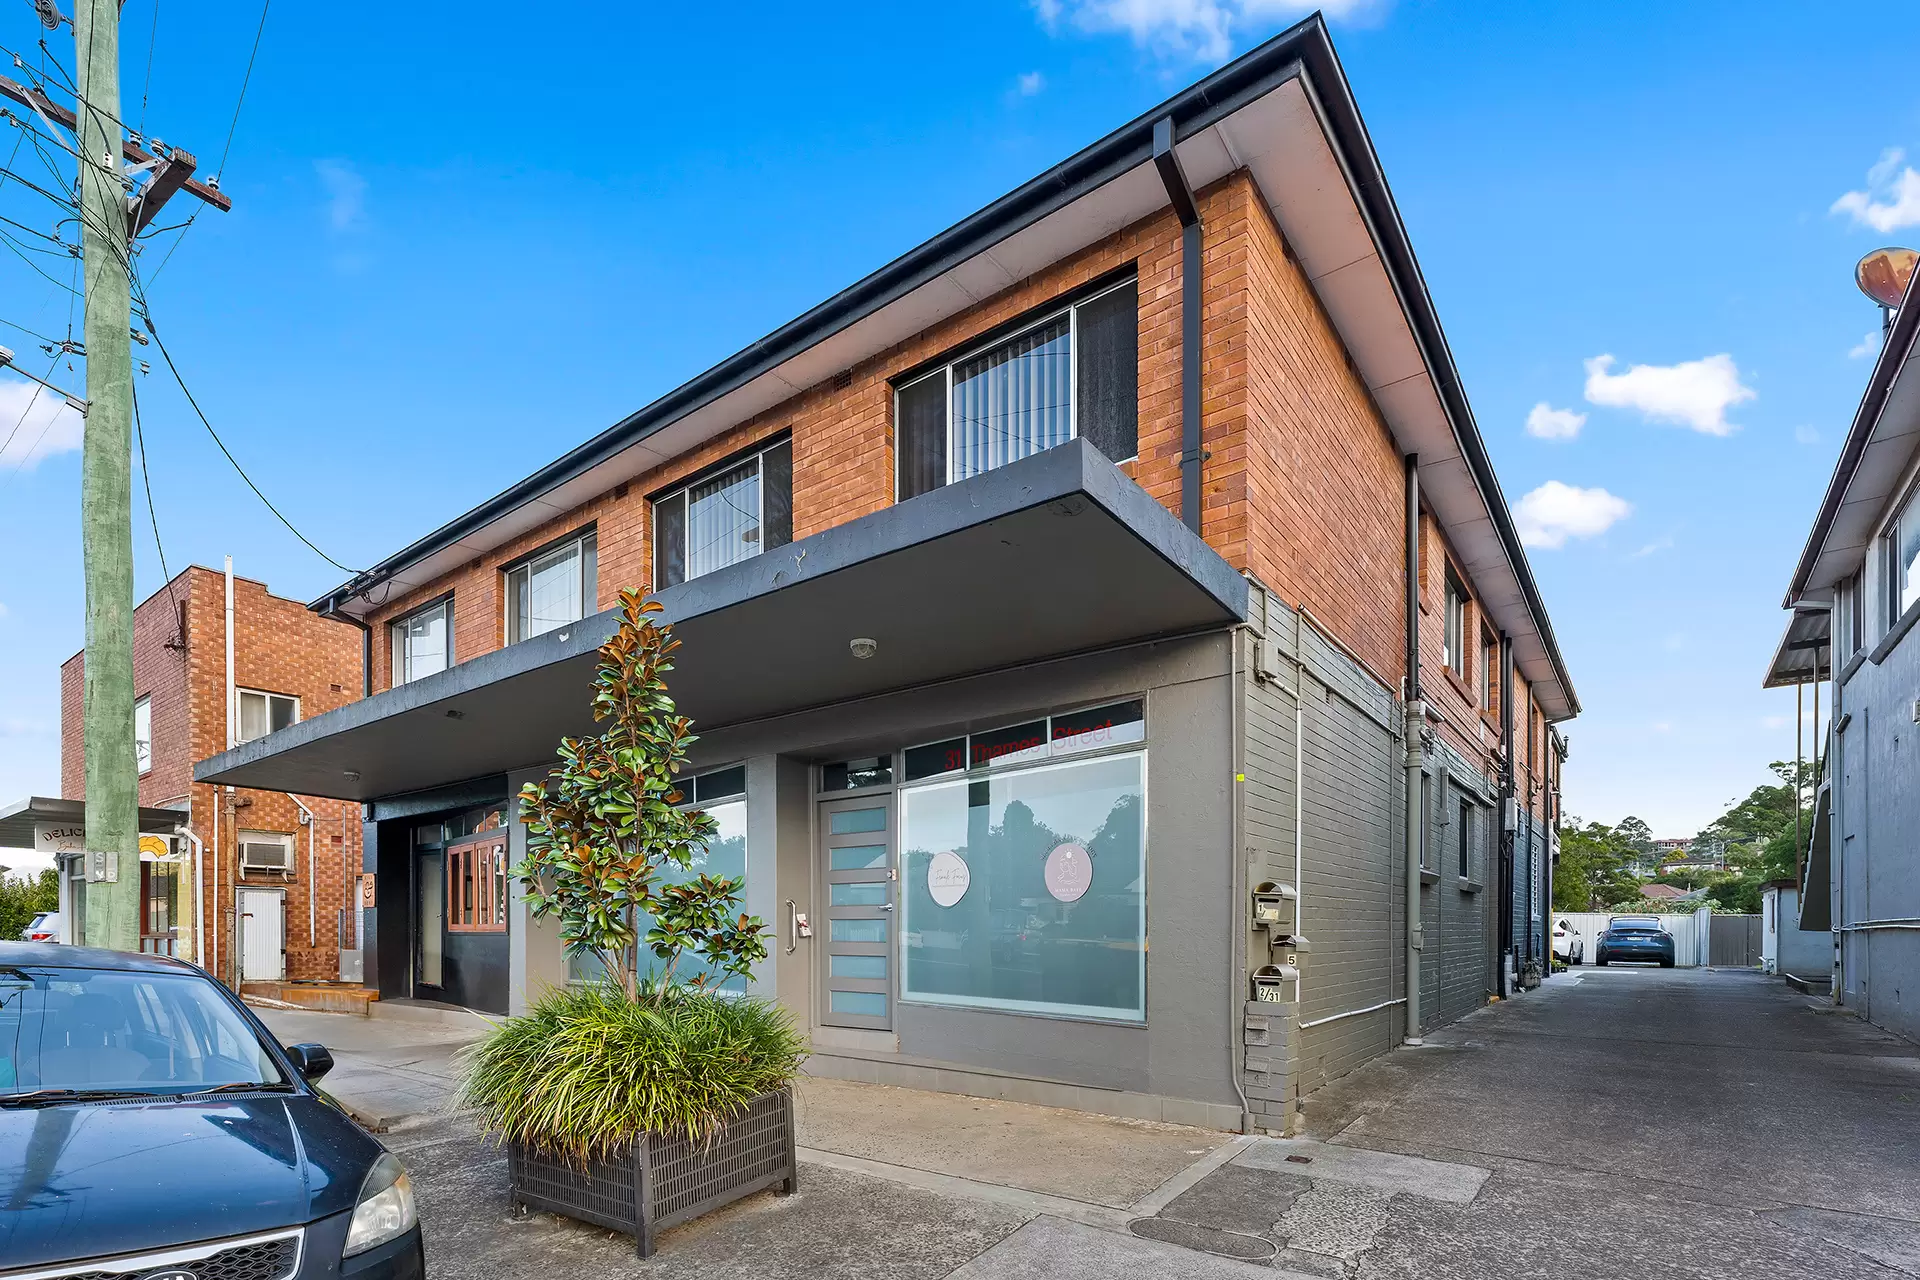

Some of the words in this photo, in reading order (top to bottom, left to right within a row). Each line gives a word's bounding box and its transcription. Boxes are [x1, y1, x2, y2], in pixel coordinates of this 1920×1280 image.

[944, 748, 961, 770] 31
[971, 736, 1041, 765] Thames
[1053, 719, 1112, 749] Street
[1288, 955, 1295, 965] 5
[1260, 987, 1280, 1002] 2/31
